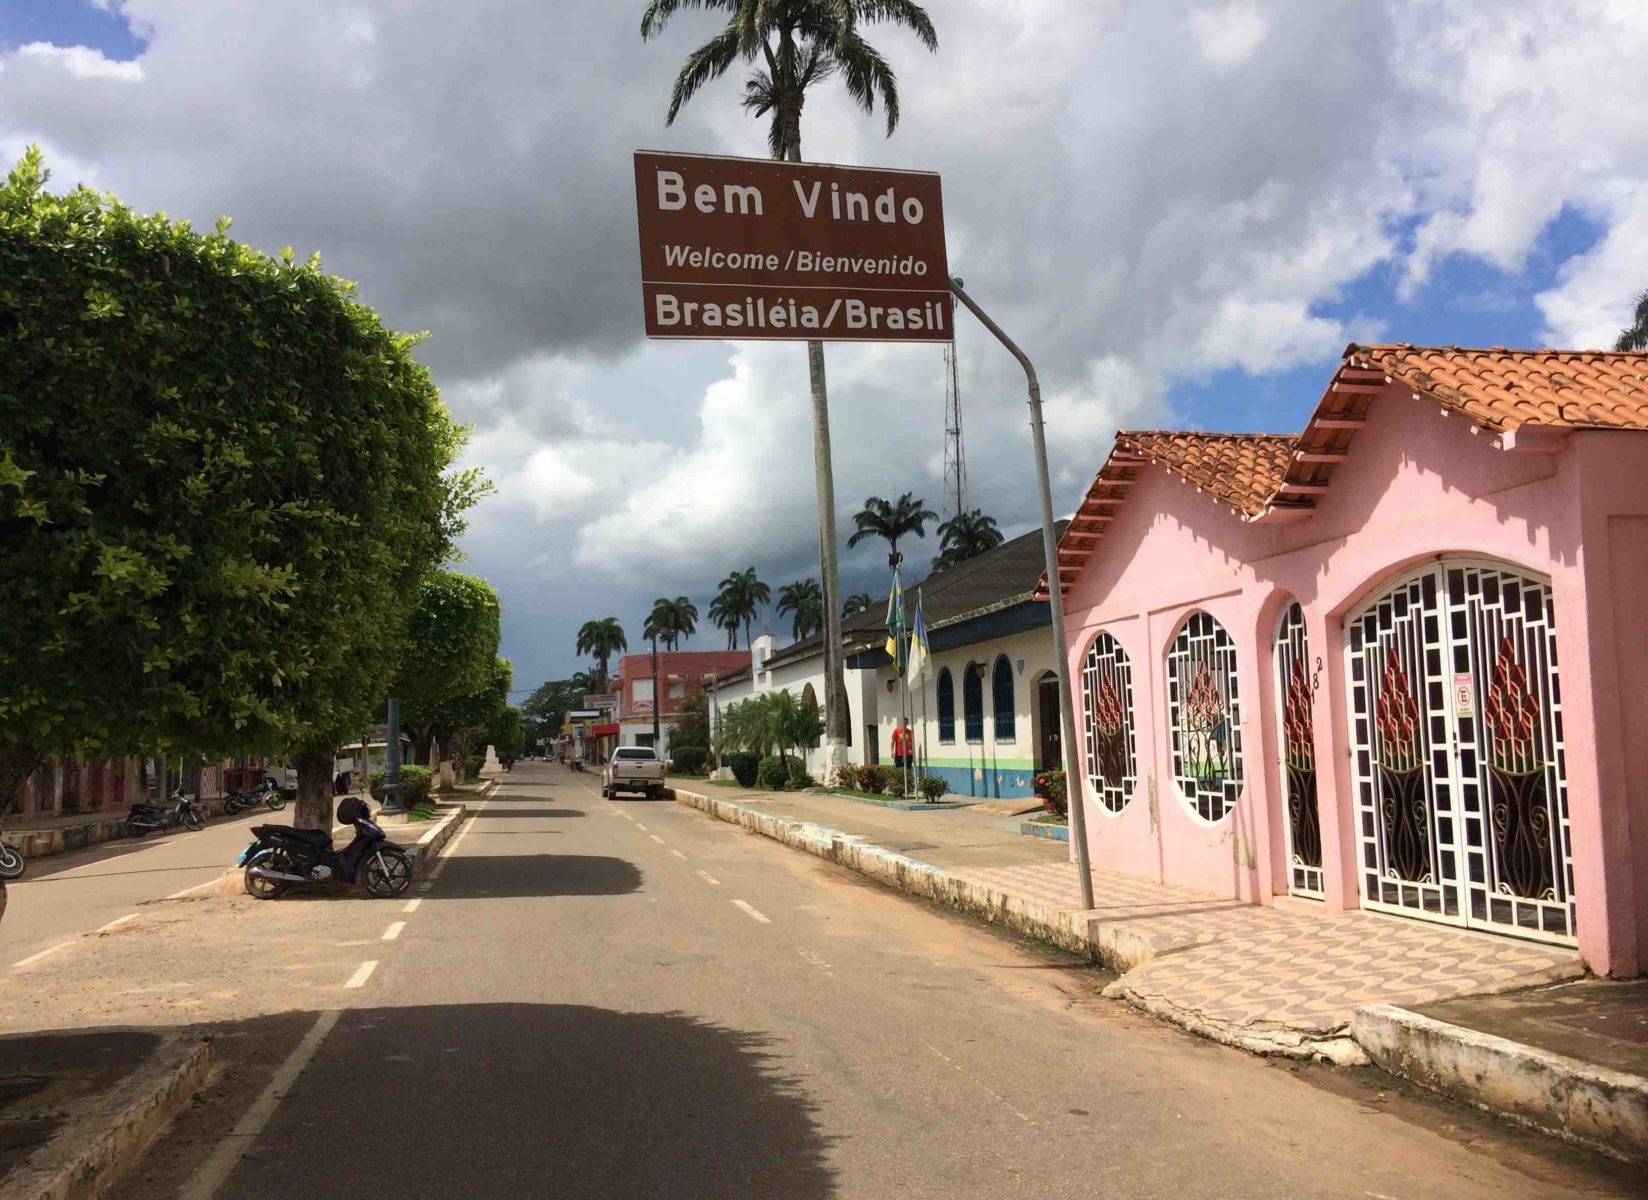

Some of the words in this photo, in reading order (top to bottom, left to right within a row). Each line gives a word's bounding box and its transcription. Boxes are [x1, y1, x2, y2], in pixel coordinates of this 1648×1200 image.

[656, 170, 763, 216] Bem
[793, 179, 924, 225] Vindo
[664, 245, 779, 271] Welcome
